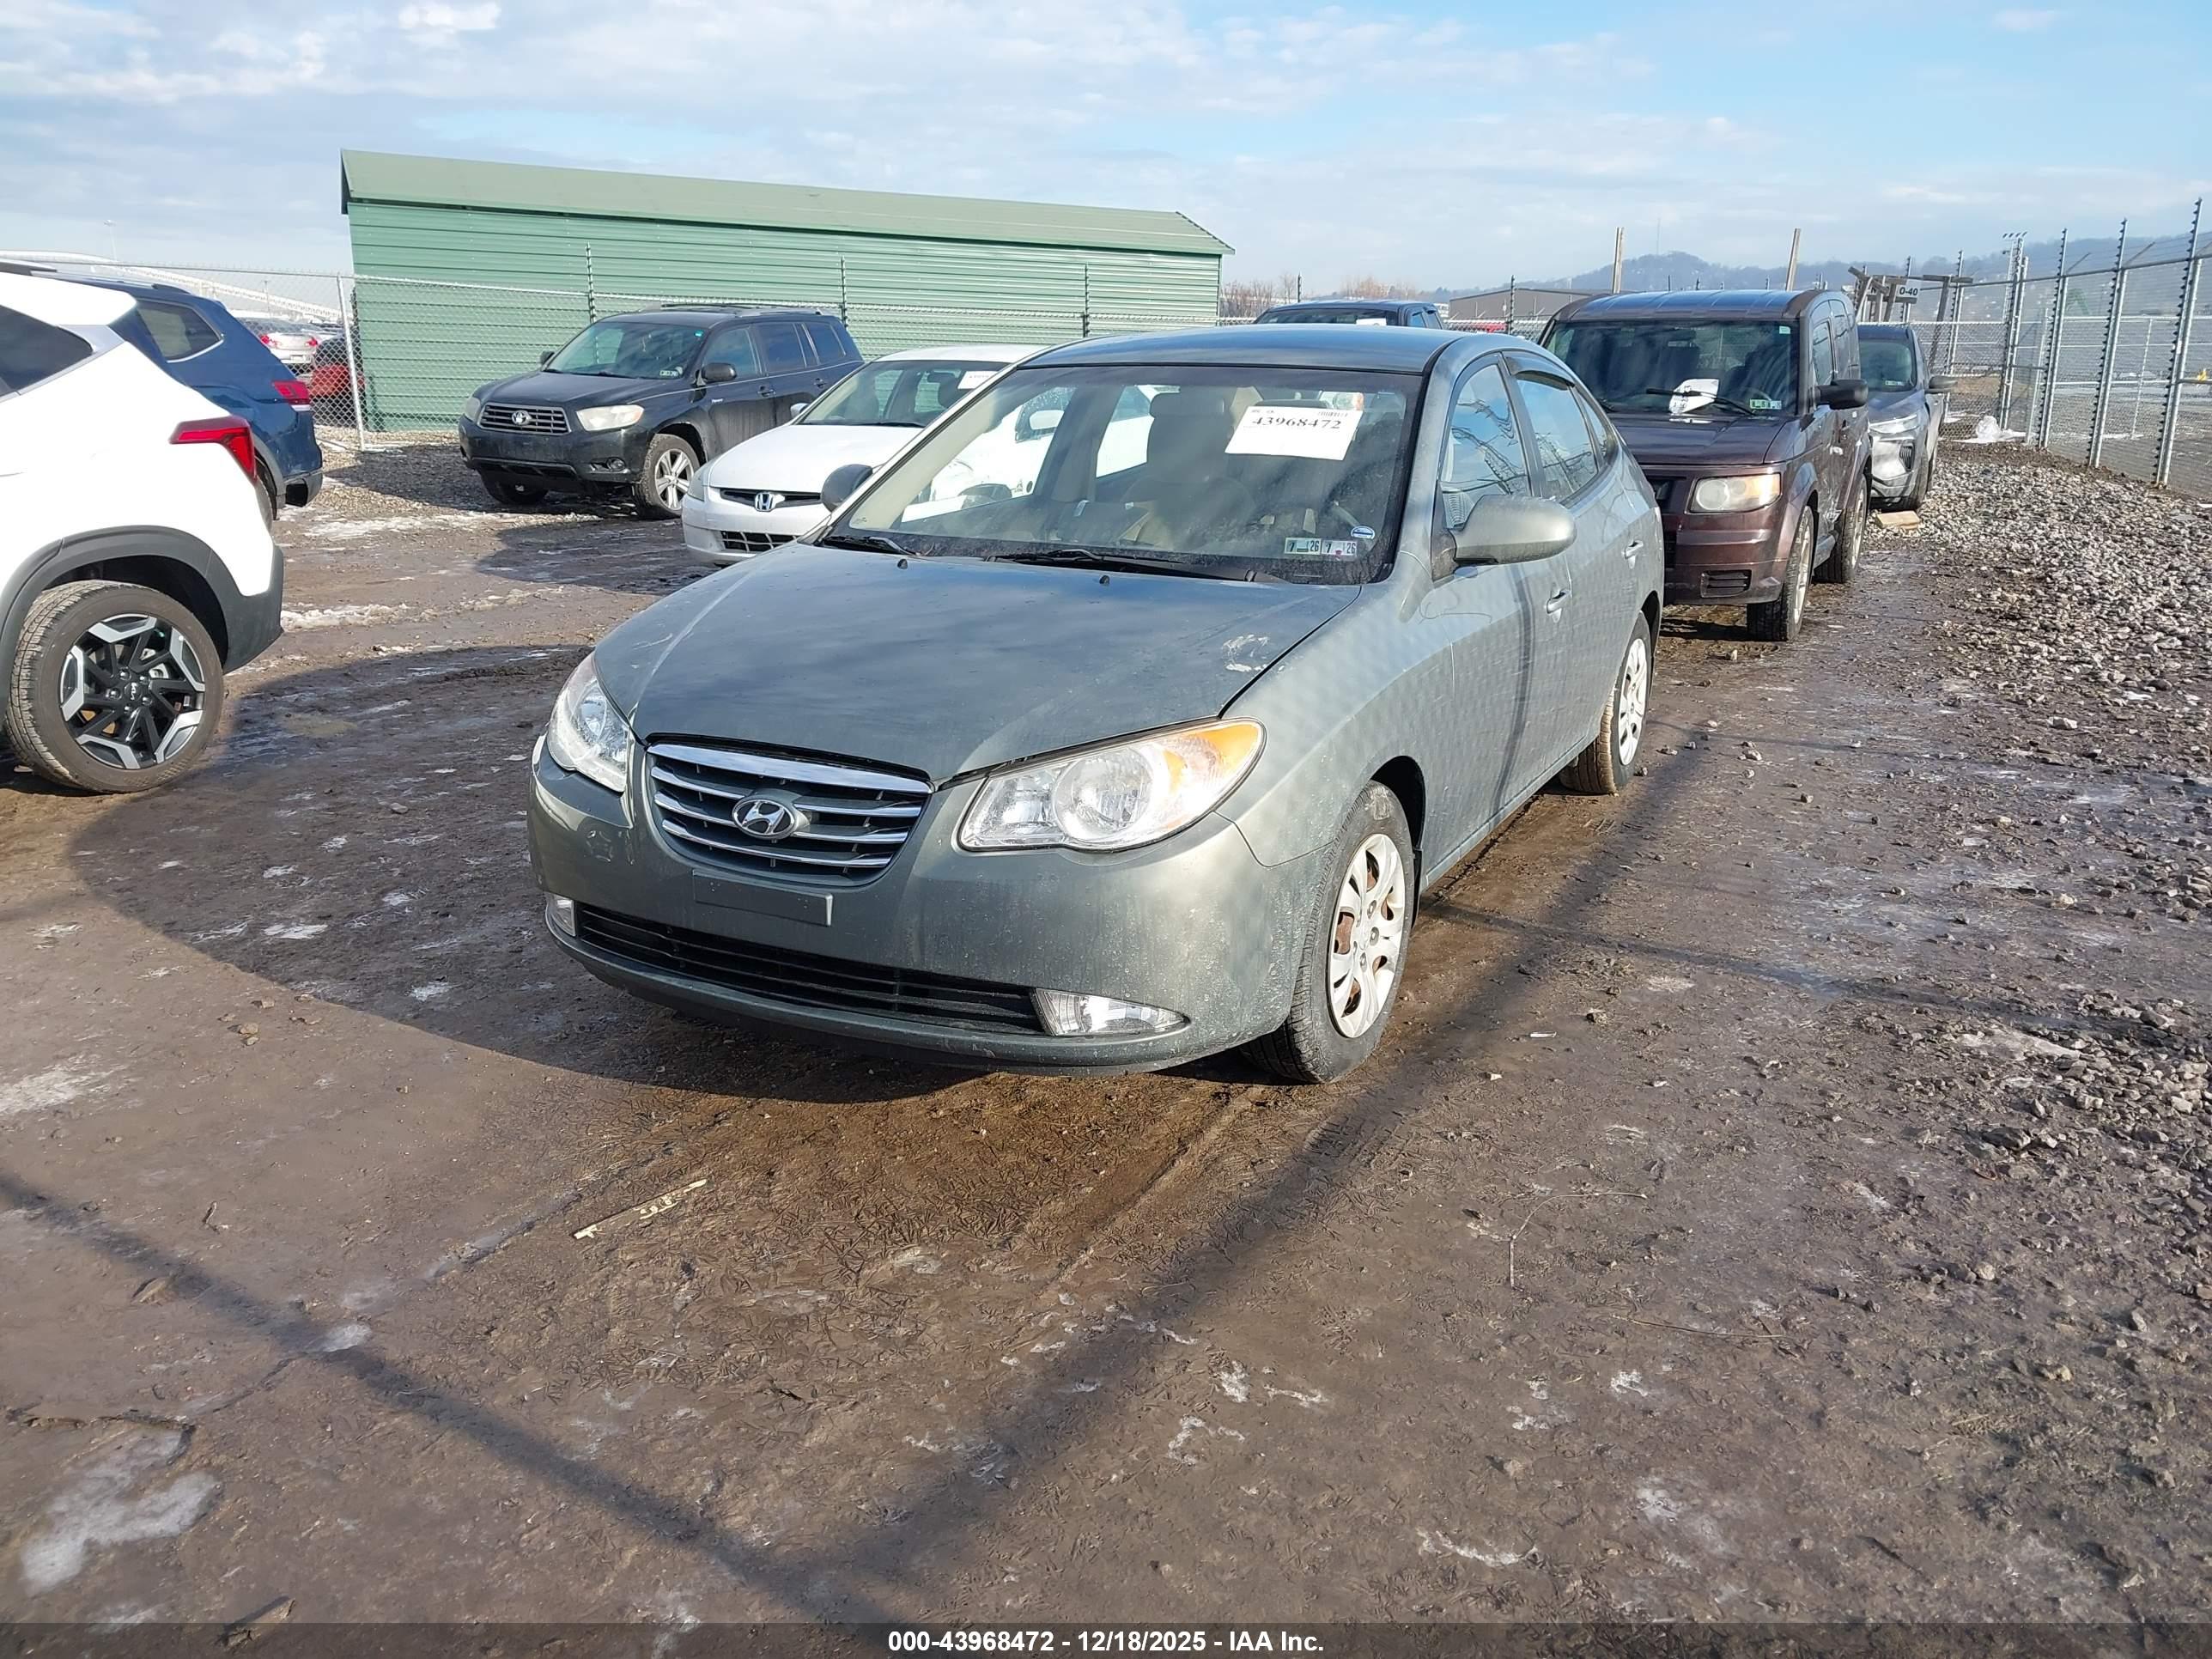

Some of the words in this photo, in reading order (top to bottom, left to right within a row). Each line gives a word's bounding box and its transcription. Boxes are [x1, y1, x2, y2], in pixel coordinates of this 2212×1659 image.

[1252, 416, 1341, 429] 43968472
[1310, 540, 1320, 552] 26
[1346, 542, 1357, 554] 26
